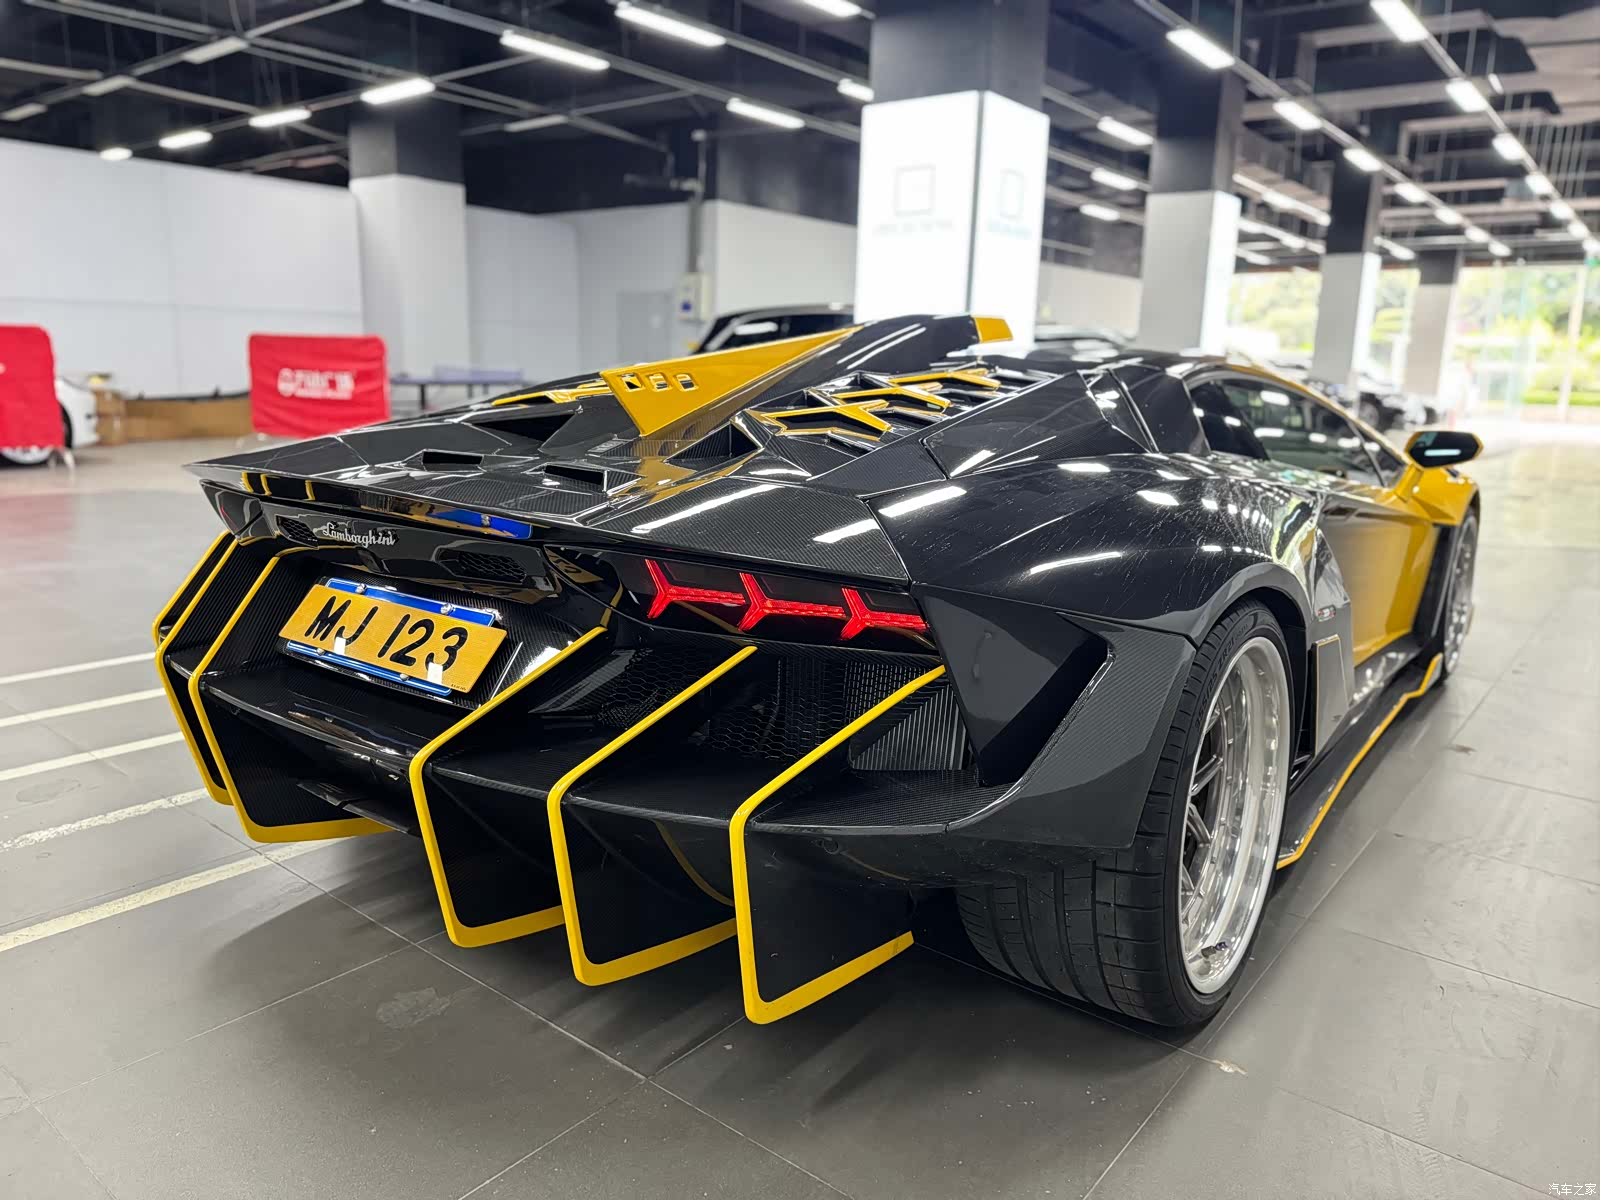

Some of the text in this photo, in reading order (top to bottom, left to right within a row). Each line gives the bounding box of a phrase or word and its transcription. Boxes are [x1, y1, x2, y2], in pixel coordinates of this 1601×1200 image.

[322, 522, 396, 548] Lamborghini
[304, 595, 469, 673] MJ 123
